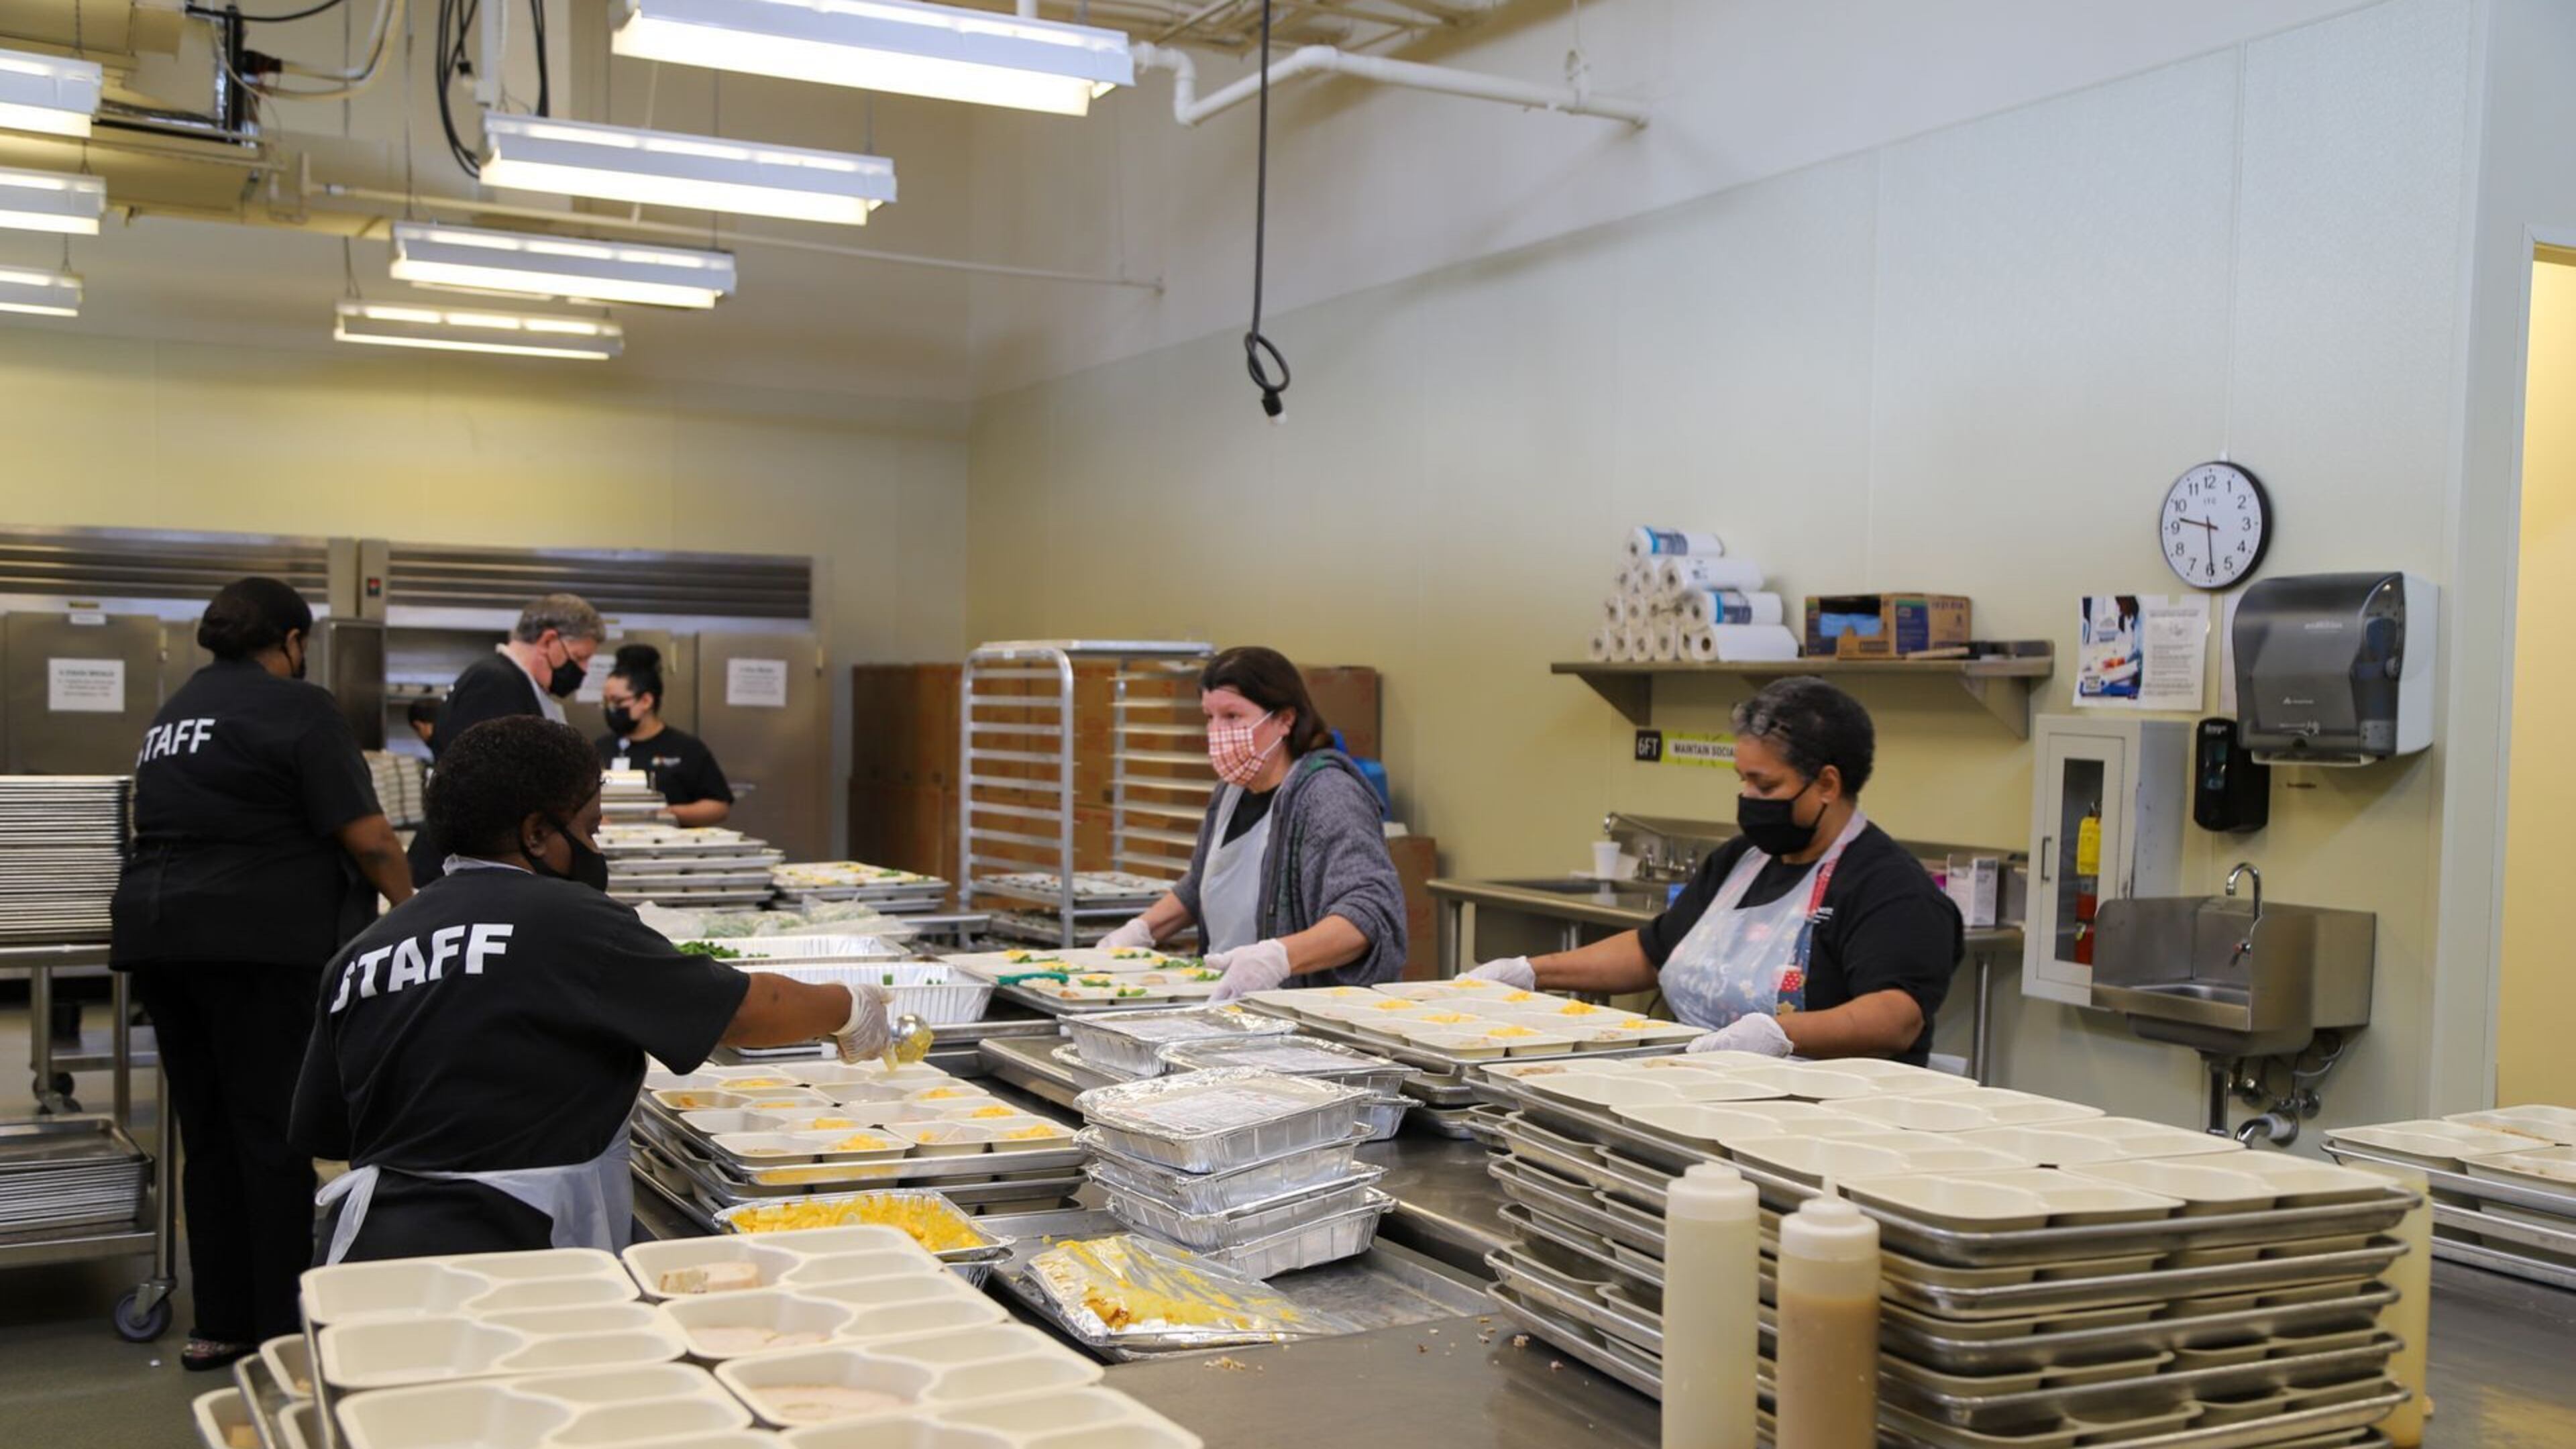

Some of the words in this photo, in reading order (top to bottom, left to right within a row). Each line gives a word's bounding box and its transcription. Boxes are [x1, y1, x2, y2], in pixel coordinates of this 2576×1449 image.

[2189, 482, 2198, 496] 11
[2204, 476, 2216, 489] 12
[2226, 480, 2232, 493] 1
[2175, 499, 2187, 512] 10
[2237, 495, 2247, 509] 2
[2171, 521, 2180, 535] 9
[2242, 517, 2251, 531] 3
[2176, 543, 2184, 556] 8
[2237, 539, 2245, 553] 4
[2189, 557, 2197, 572] 7
[2206, 563, 2214, 577] 6
[2224, 556, 2233, 570] 5
[1638, 737, 1659, 757] 6FT
[1674, 743, 1709, 755] MAINTAIN
[329, 924, 514, 1014] STAFF
